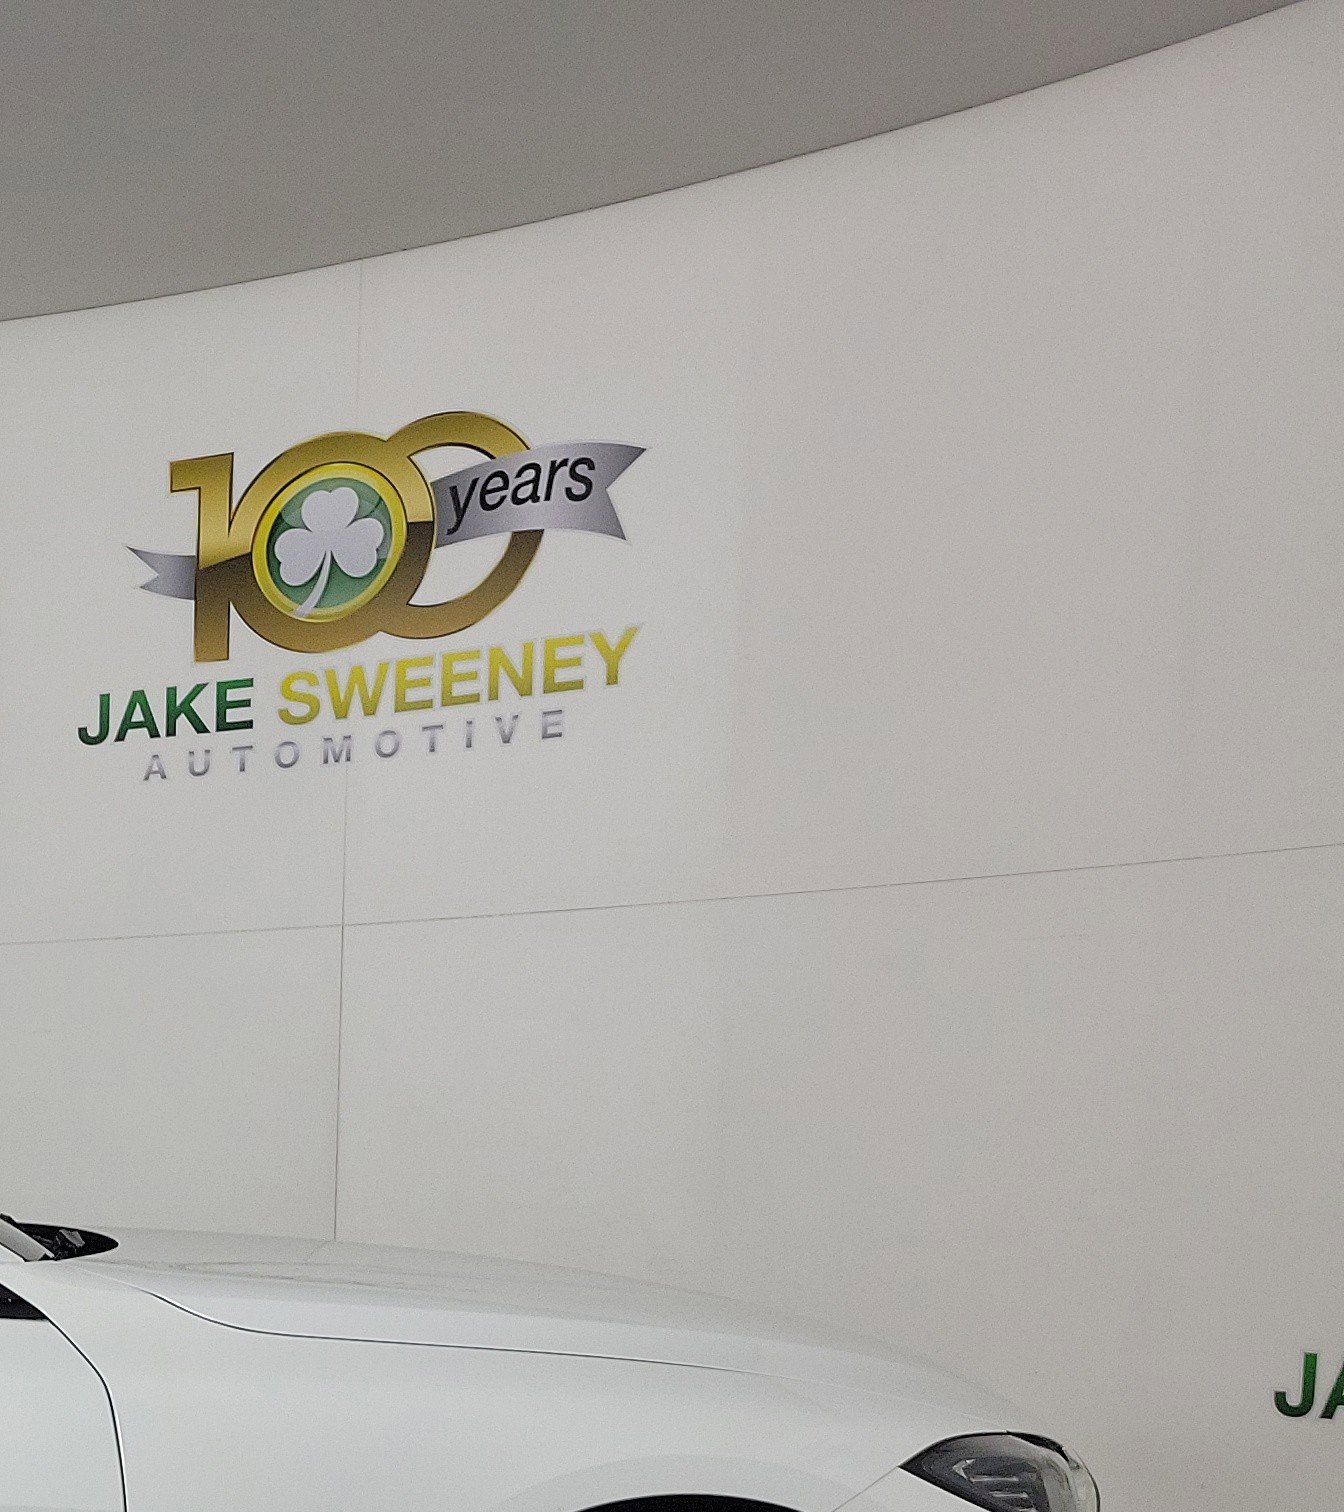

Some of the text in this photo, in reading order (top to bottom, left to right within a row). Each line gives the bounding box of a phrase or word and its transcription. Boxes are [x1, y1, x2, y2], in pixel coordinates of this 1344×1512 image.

[169, 410, 596, 663] 100 years
[77, 625, 641, 747] JAKE SWEENEY
[142, 709, 565, 782] AUTOMOTIVE
